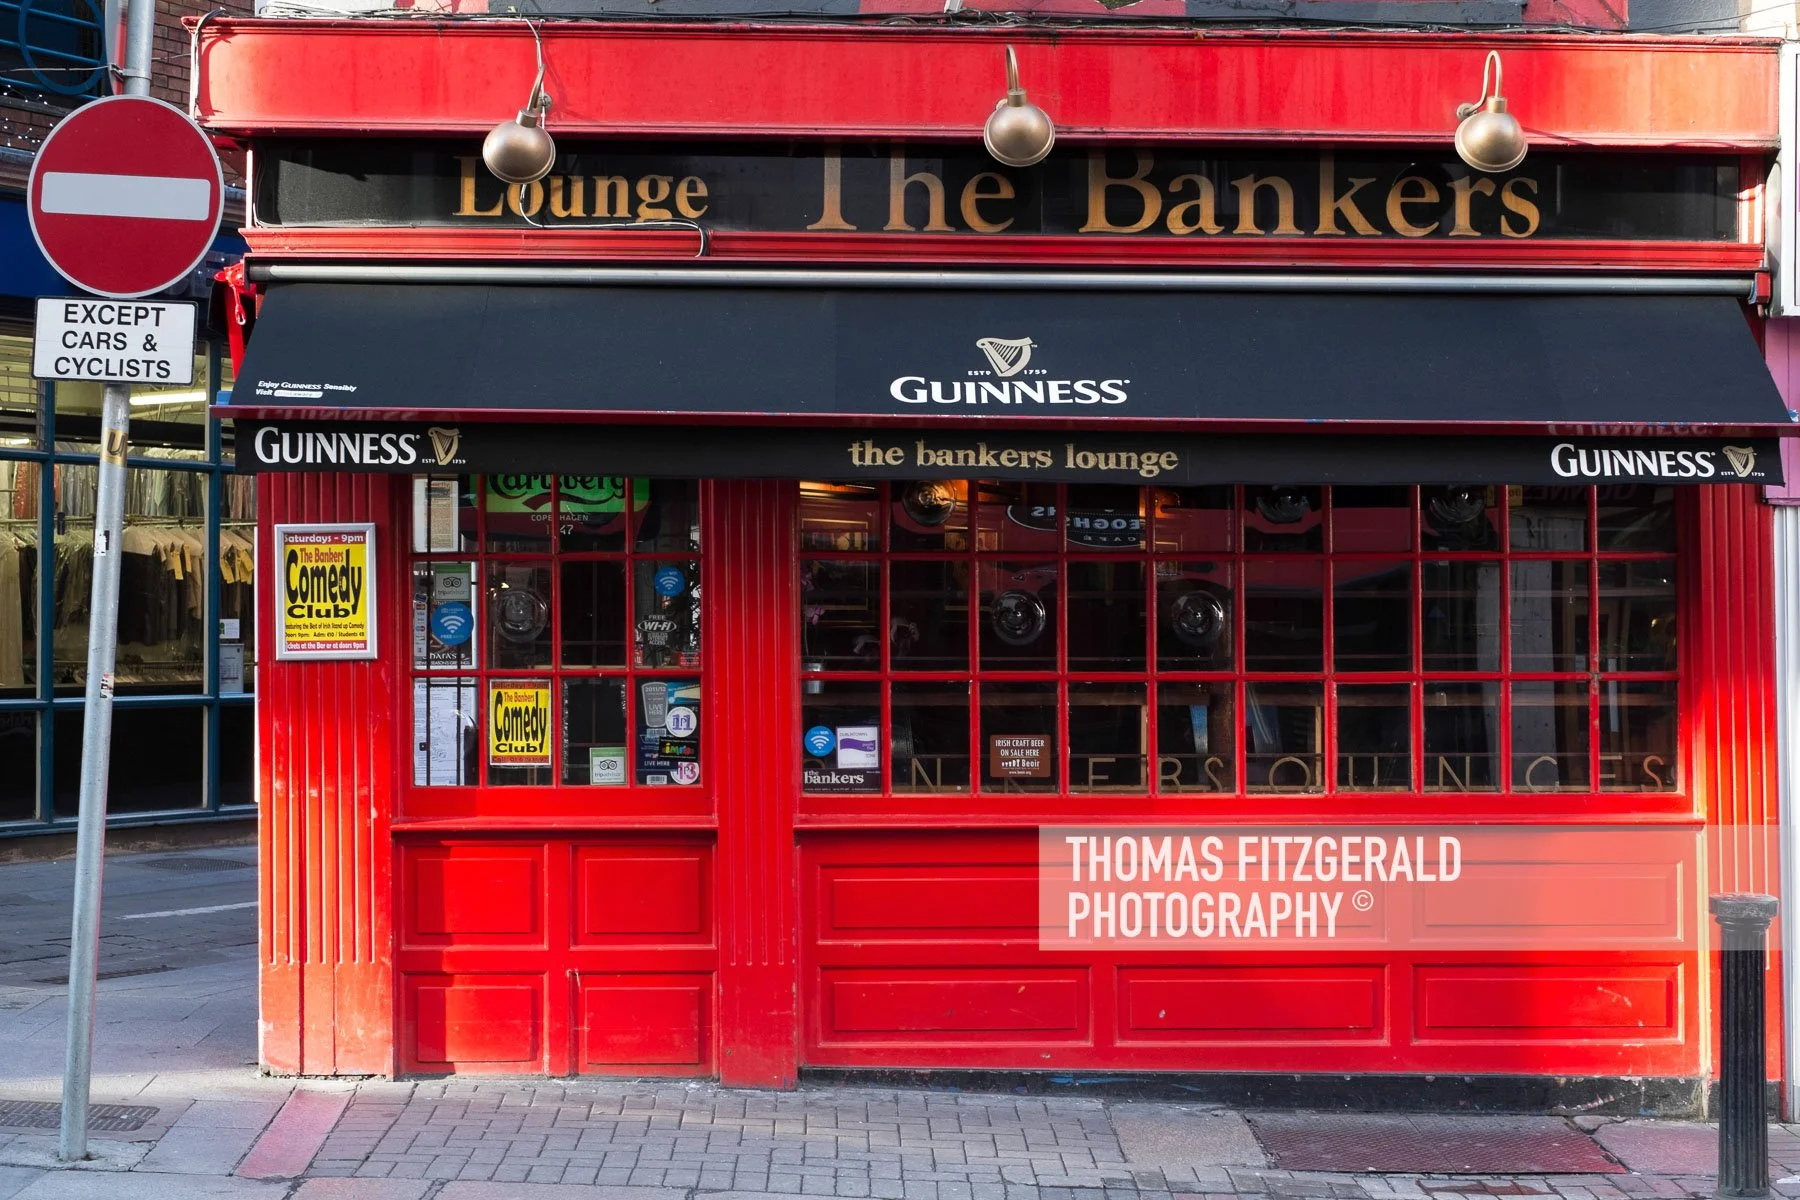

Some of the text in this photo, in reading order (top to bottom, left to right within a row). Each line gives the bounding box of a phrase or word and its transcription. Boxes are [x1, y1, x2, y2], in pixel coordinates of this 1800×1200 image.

[452, 155, 709, 224] Lounge
[1078, 146, 1541, 238] Bankers
[64, 303, 166, 327] EXCEPT
[62, 330, 158, 352] CARS &
[54, 356, 171, 379] CYCLISTS
[255, 388, 273, 396] Visit
[258, 380, 357, 393] Enjoy GUINNESS Sensibly
[890, 376, 1128, 404] GUINNESS
[254, 426, 417, 465] GUINNESS
[848, 438, 1179, 477] the bankers lounge
[1551, 443, 1716, 477] GUINNESS
[546, 524, 574, 535] 147
[284, 534, 331, 543] Saturdays
[341, 534, 363, 543] 9pm
[300, 548, 343, 563] The Bankers
[286, 549, 362, 615] Comedy
[287, 605, 350, 618] Club
[644, 621, 672, 631] WI-FI
[504, 692, 534, 702] The Bankers
[494, 691, 547, 753] Comedy
[495, 743, 538, 753] Club
[995, 739, 1044, 747] IRISH CRAFT BEER
[1021, 759, 1040, 767] Beoir
[804, 771, 864, 784] bankers
